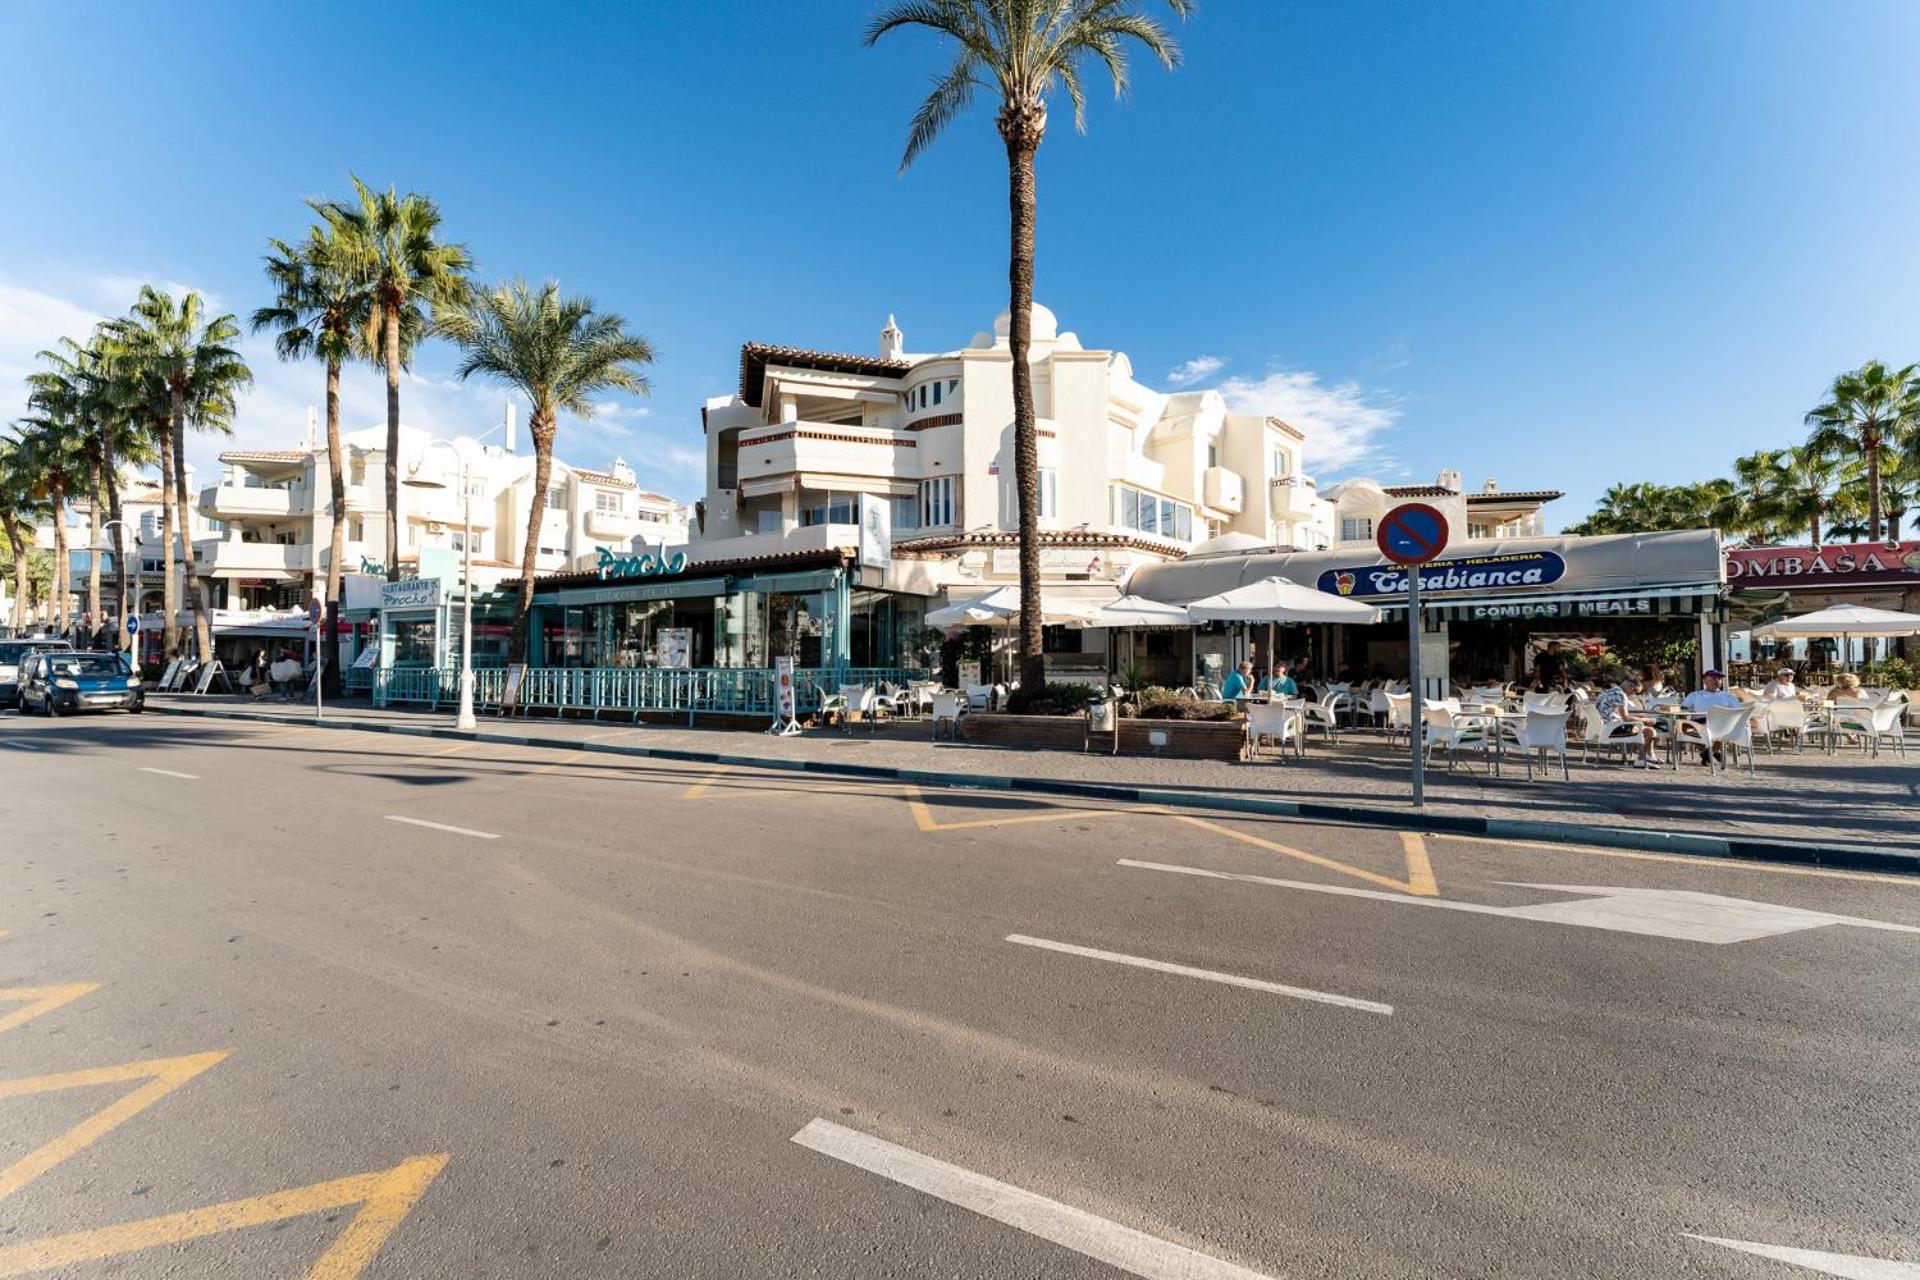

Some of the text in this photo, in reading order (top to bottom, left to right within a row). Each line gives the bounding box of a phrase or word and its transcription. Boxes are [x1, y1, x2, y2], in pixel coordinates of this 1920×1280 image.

[1387, 561, 1454, 571] CATERIA
[1466, 553, 1543, 566] HELADERIA
[1726, 552, 1887, 579] OMBASA
[382, 580, 429, 593] RESTAURANTE
[1369, 568, 1542, 593] Casabianca
[1475, 604, 1558, 617] COMIDAS
[1579, 600, 1650, 613] MEALS
